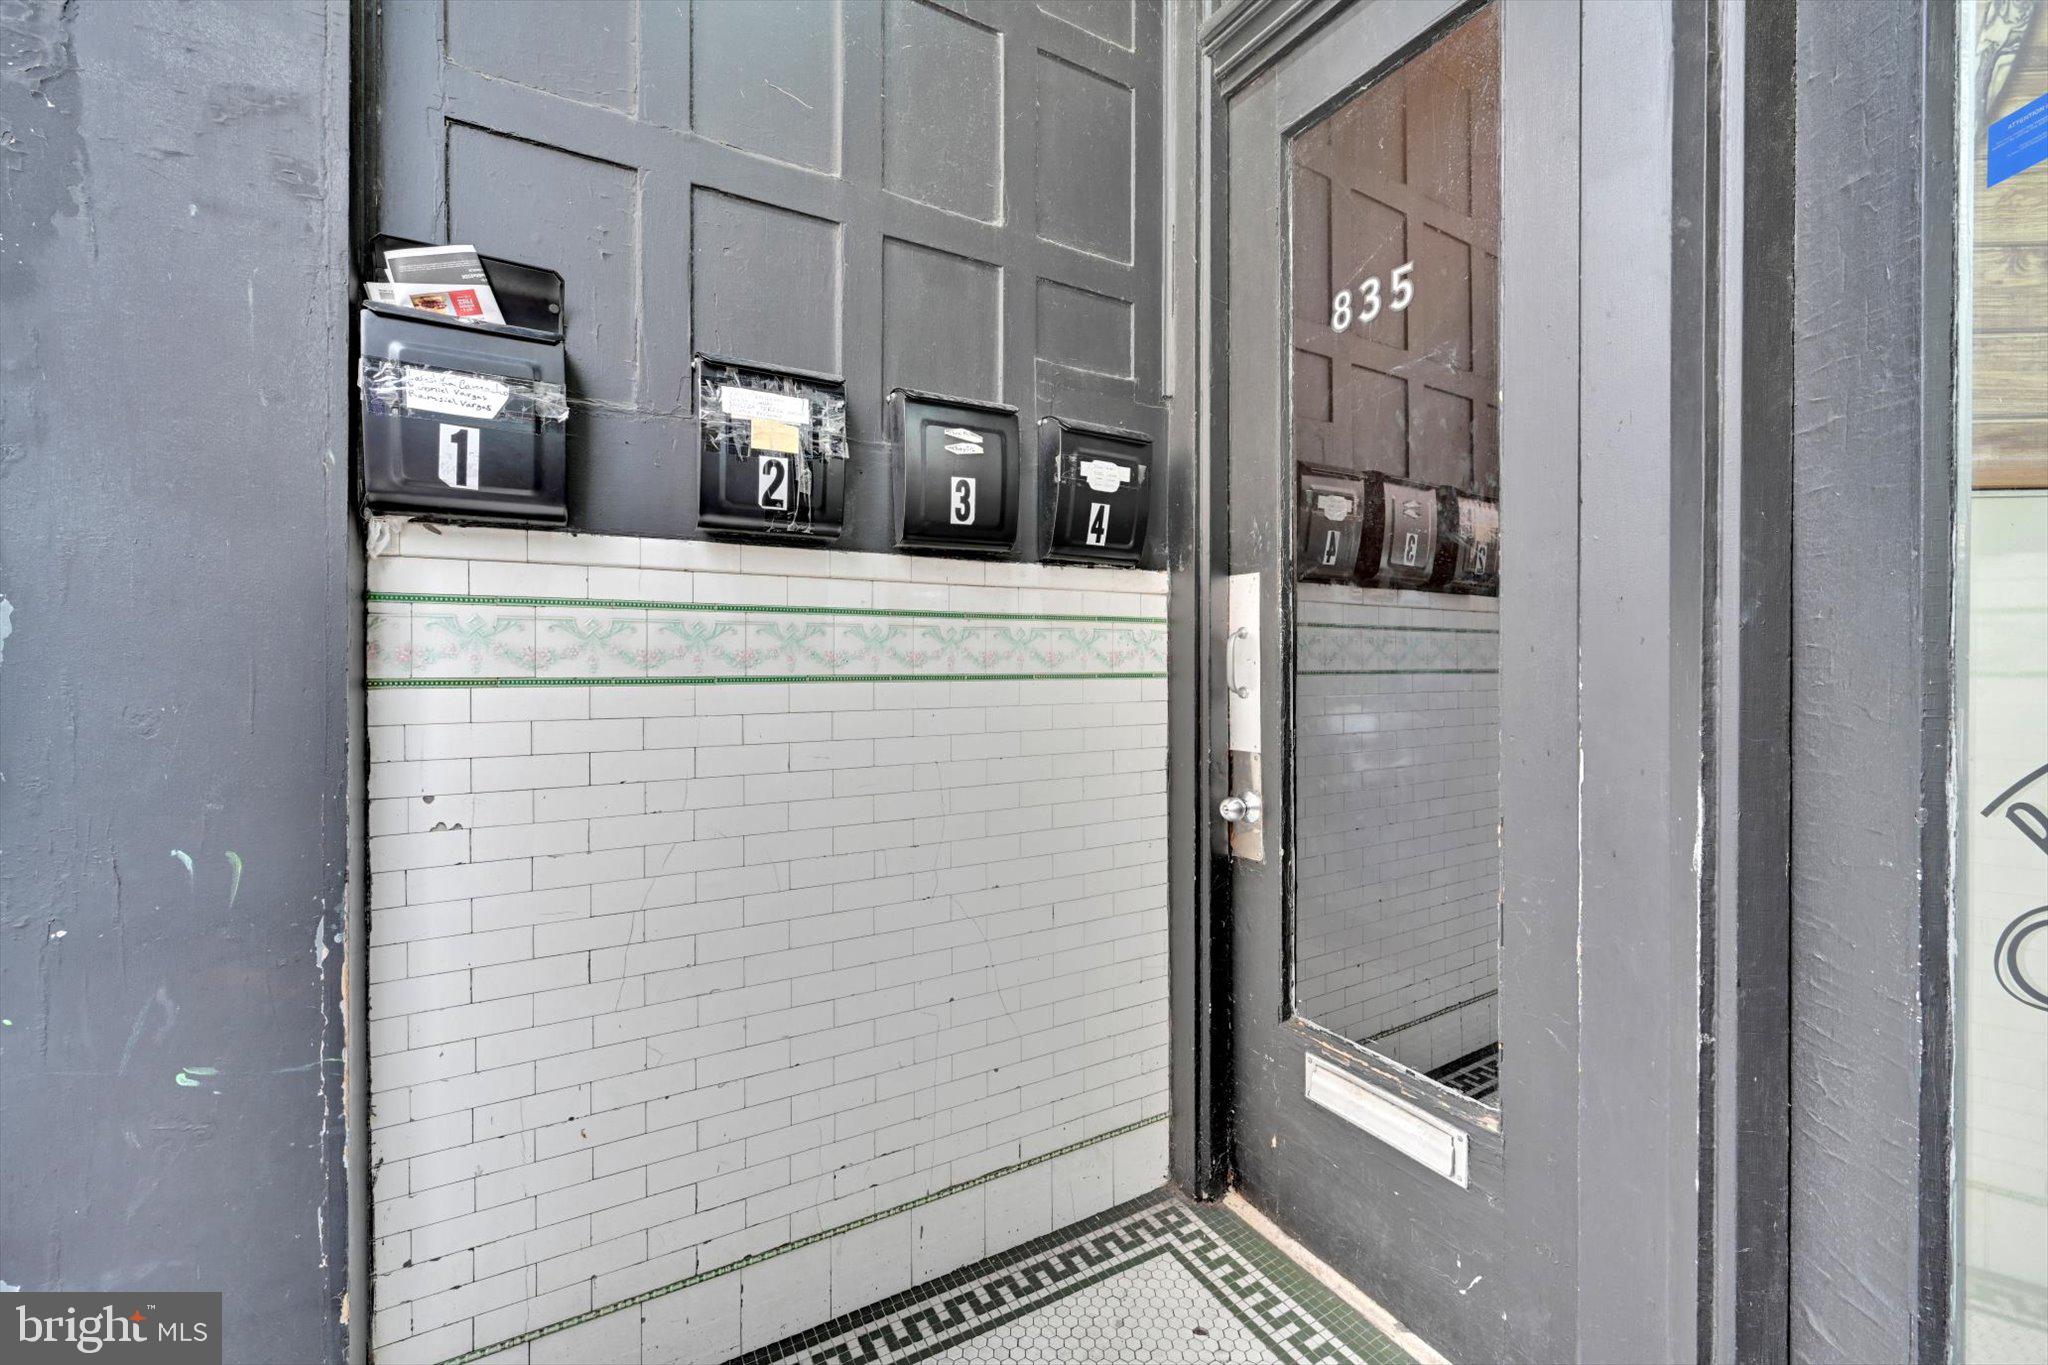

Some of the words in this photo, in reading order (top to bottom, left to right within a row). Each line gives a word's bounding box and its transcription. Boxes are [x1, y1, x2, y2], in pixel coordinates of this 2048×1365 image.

[1332, 261, 1414, 333] 835
[460, 400, 493, 412] Vargas
[451, 429, 468, 487] 1
[761, 459, 785, 509] 2
[955, 479, 971, 522] 3
[1090, 505, 1105, 543] 4
